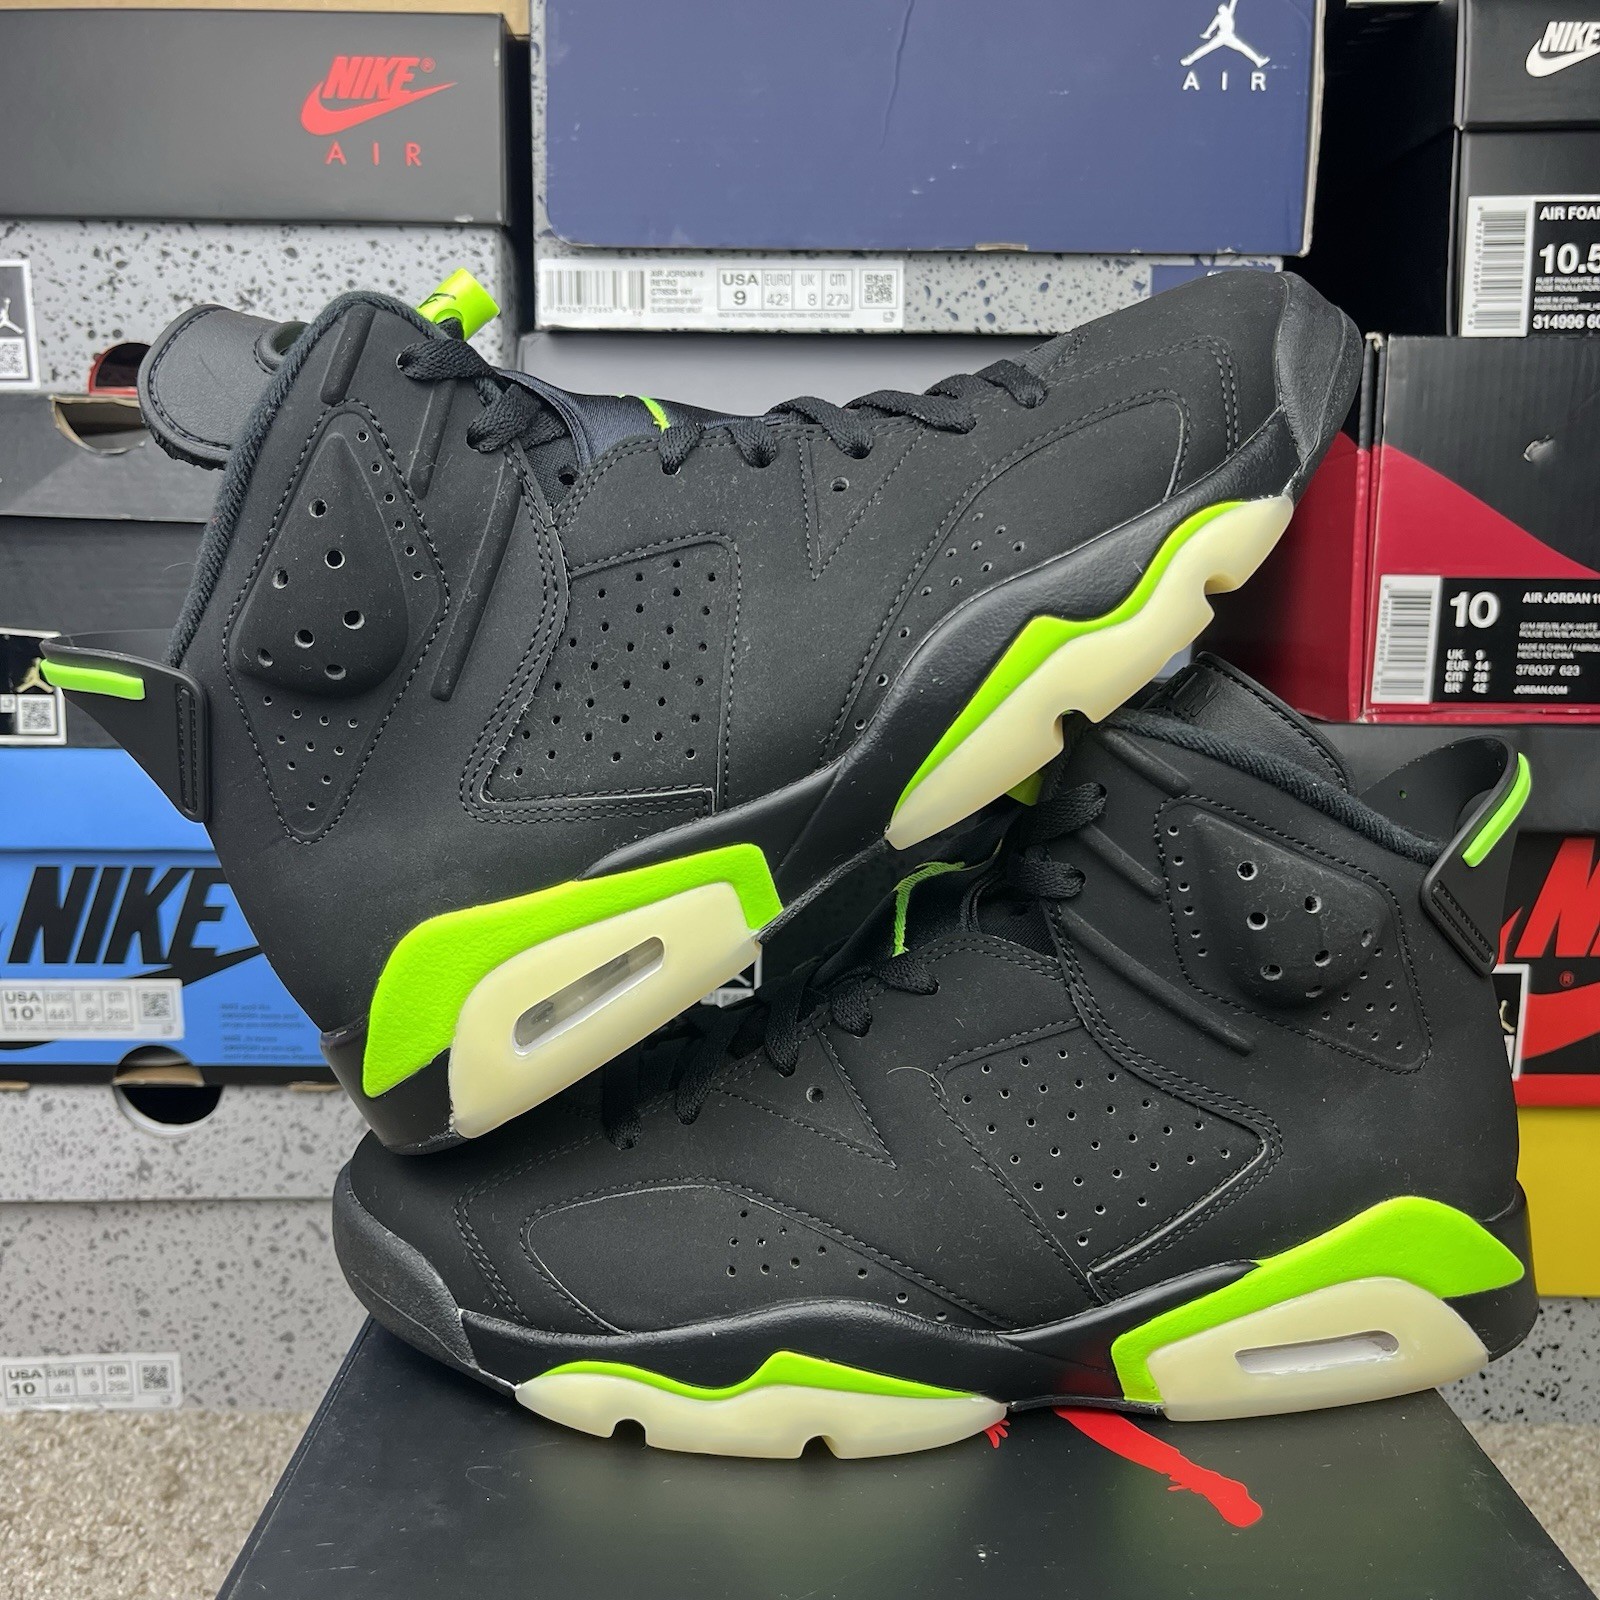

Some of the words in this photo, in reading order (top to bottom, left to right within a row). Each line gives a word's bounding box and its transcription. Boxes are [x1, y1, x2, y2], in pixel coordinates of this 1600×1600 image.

[1540, 21, 1600, 53] NIKE
[321, 56, 420, 99] NIKE
[1182, 71, 1267, 91] AIR
[325, 138, 422, 167] AIR
[1539, 205, 1565, 220] AIR
[722, 273, 759, 286] USA
[764, 273, 791, 287] EURO
[800, 273, 816, 287] UK
[733, 290, 747, 305] 9
[807, 293, 817, 306] 8
[1532, 314, 1585, 330] 314996
[1522, 592, 1543, 604] AIR
[1544, 592, 1591, 604] JORDAN
[1450, 591, 1500, 628] 10
[1447, 649, 1465, 660] UK
[1475, 649, 1486, 661] 9
[1446, 660, 1470, 671] EUR
[1474, 660, 1490, 671] 44
[1559, 664, 1581, 677] 623
[1472, 682, 1488, 693] 42
[1513, 685, 1569, 695] JORDAN.COM
[8, 866, 229, 965] NIKE
[5, 991, 41, 1003] USA
[8, 1368, 42, 1380] USA
[11, 1382, 36, 1395] 10
